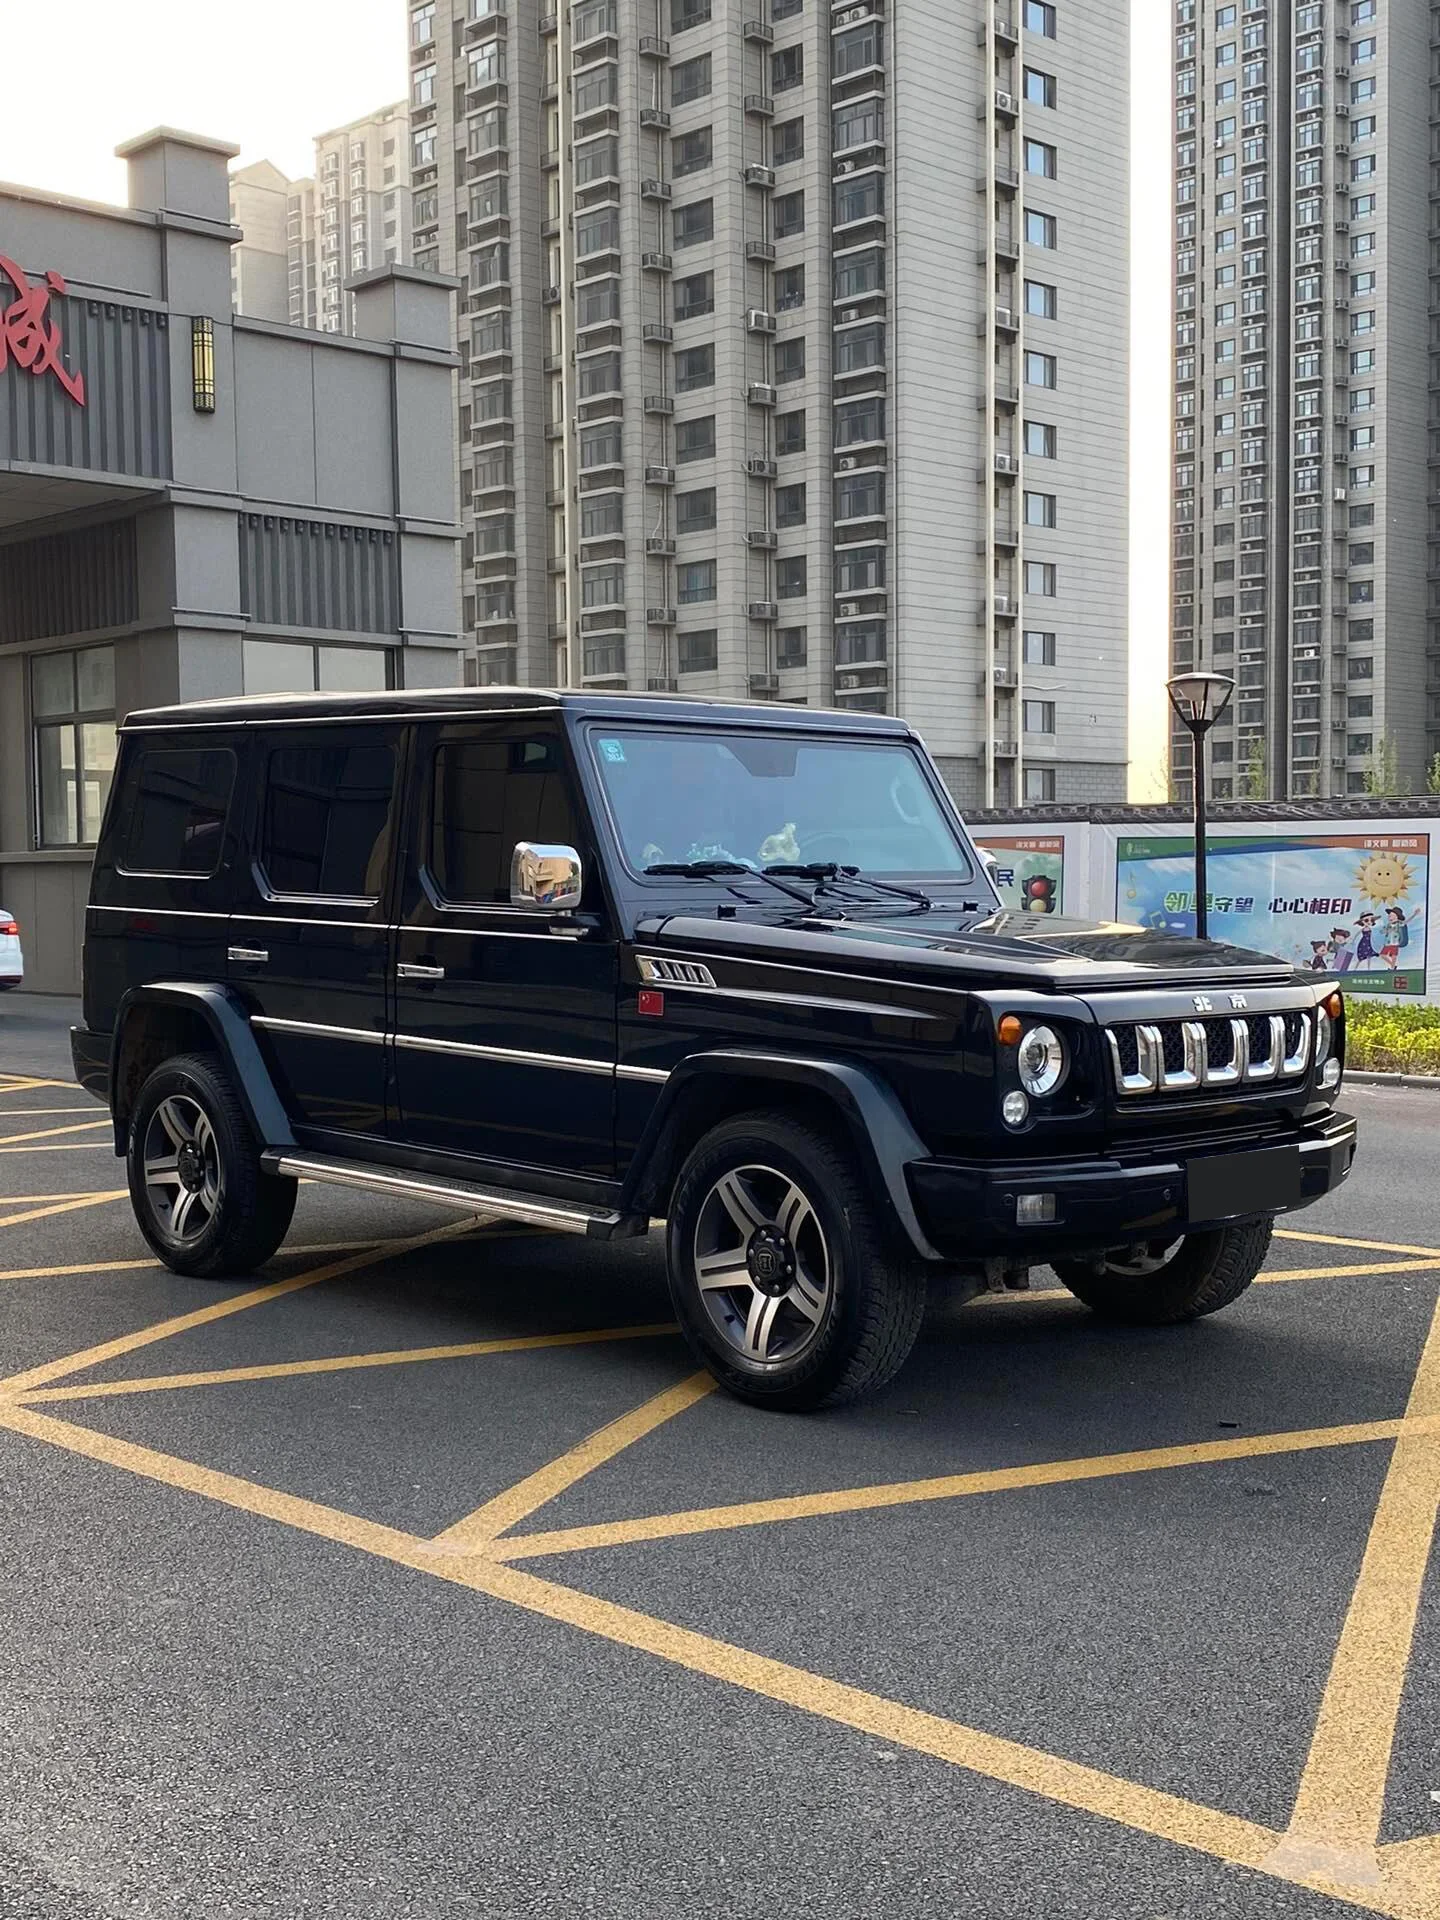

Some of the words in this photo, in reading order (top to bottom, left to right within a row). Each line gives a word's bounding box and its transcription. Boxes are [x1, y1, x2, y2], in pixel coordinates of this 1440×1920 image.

[1165, 891, 1254, 913] 邻里守望
[1268, 897, 1353, 915] 心心相印
[1192, 994, 1248, 1011] 北京
